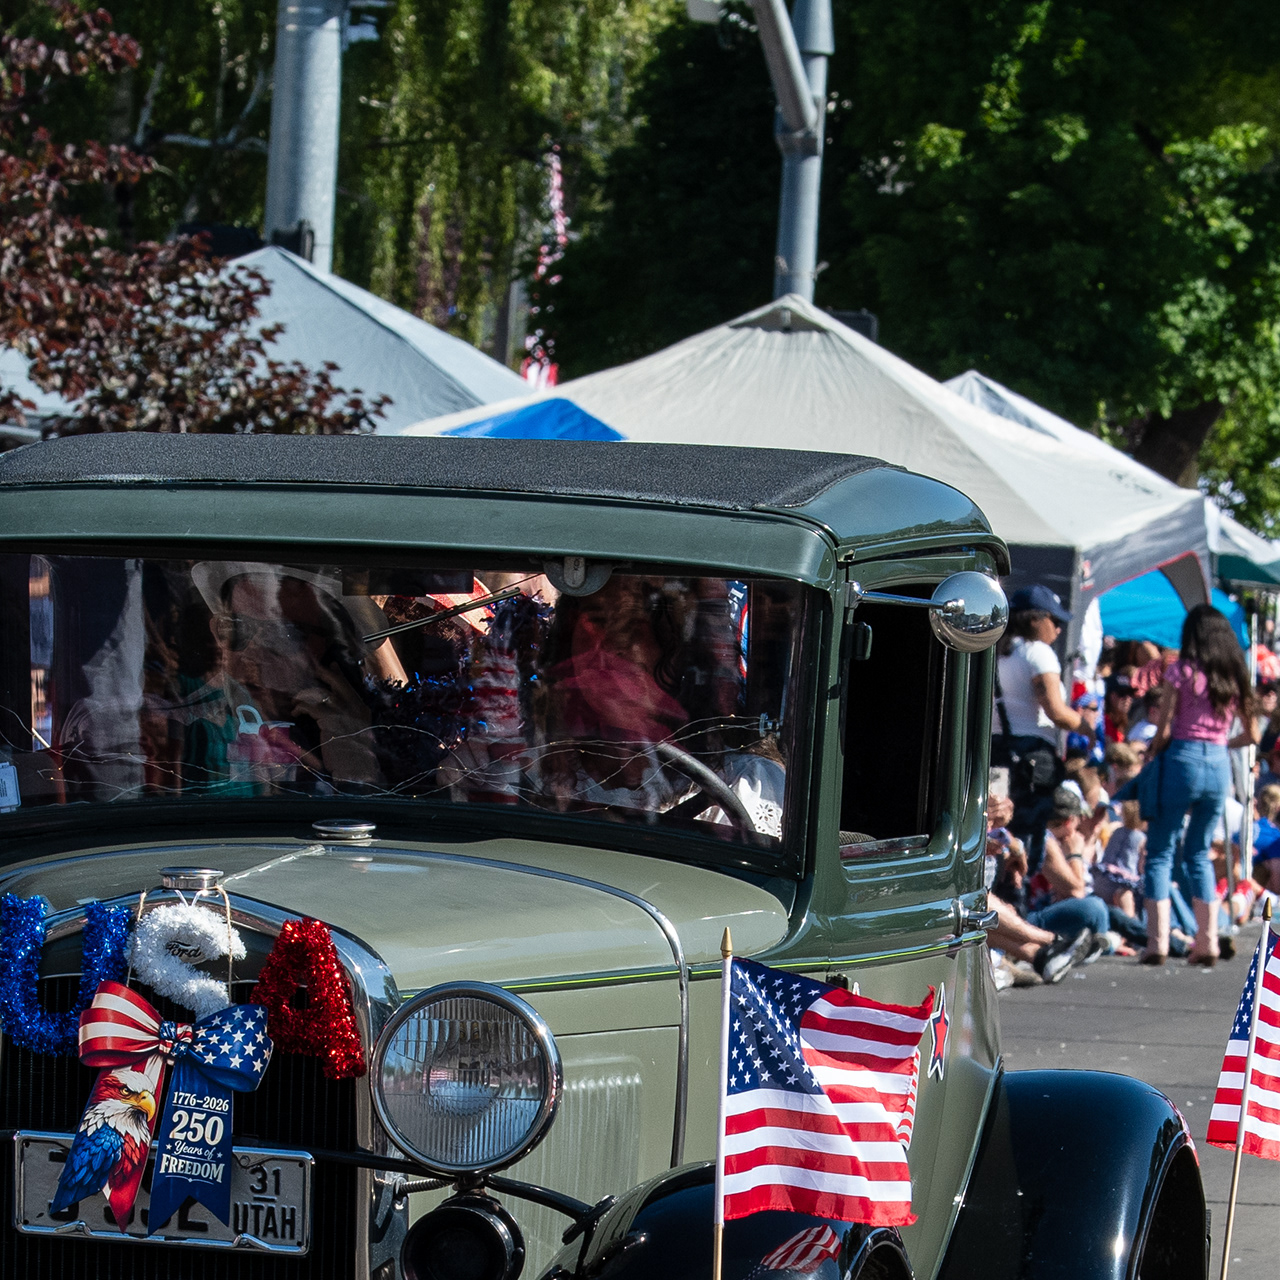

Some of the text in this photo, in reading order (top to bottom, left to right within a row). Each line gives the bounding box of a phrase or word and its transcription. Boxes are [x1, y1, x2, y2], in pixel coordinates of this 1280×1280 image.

[165, 939, 202, 958] Ford
[172, 1091, 229, 1112] 1776-2026
[168, 1109, 224, 1146] 250
[173, 1140, 216, 1160] Years of
[159, 1153, 225, 1183] FREEDOM
[249, 1166, 282, 1196] 31
[232, 1201, 297, 1241] UTAH
